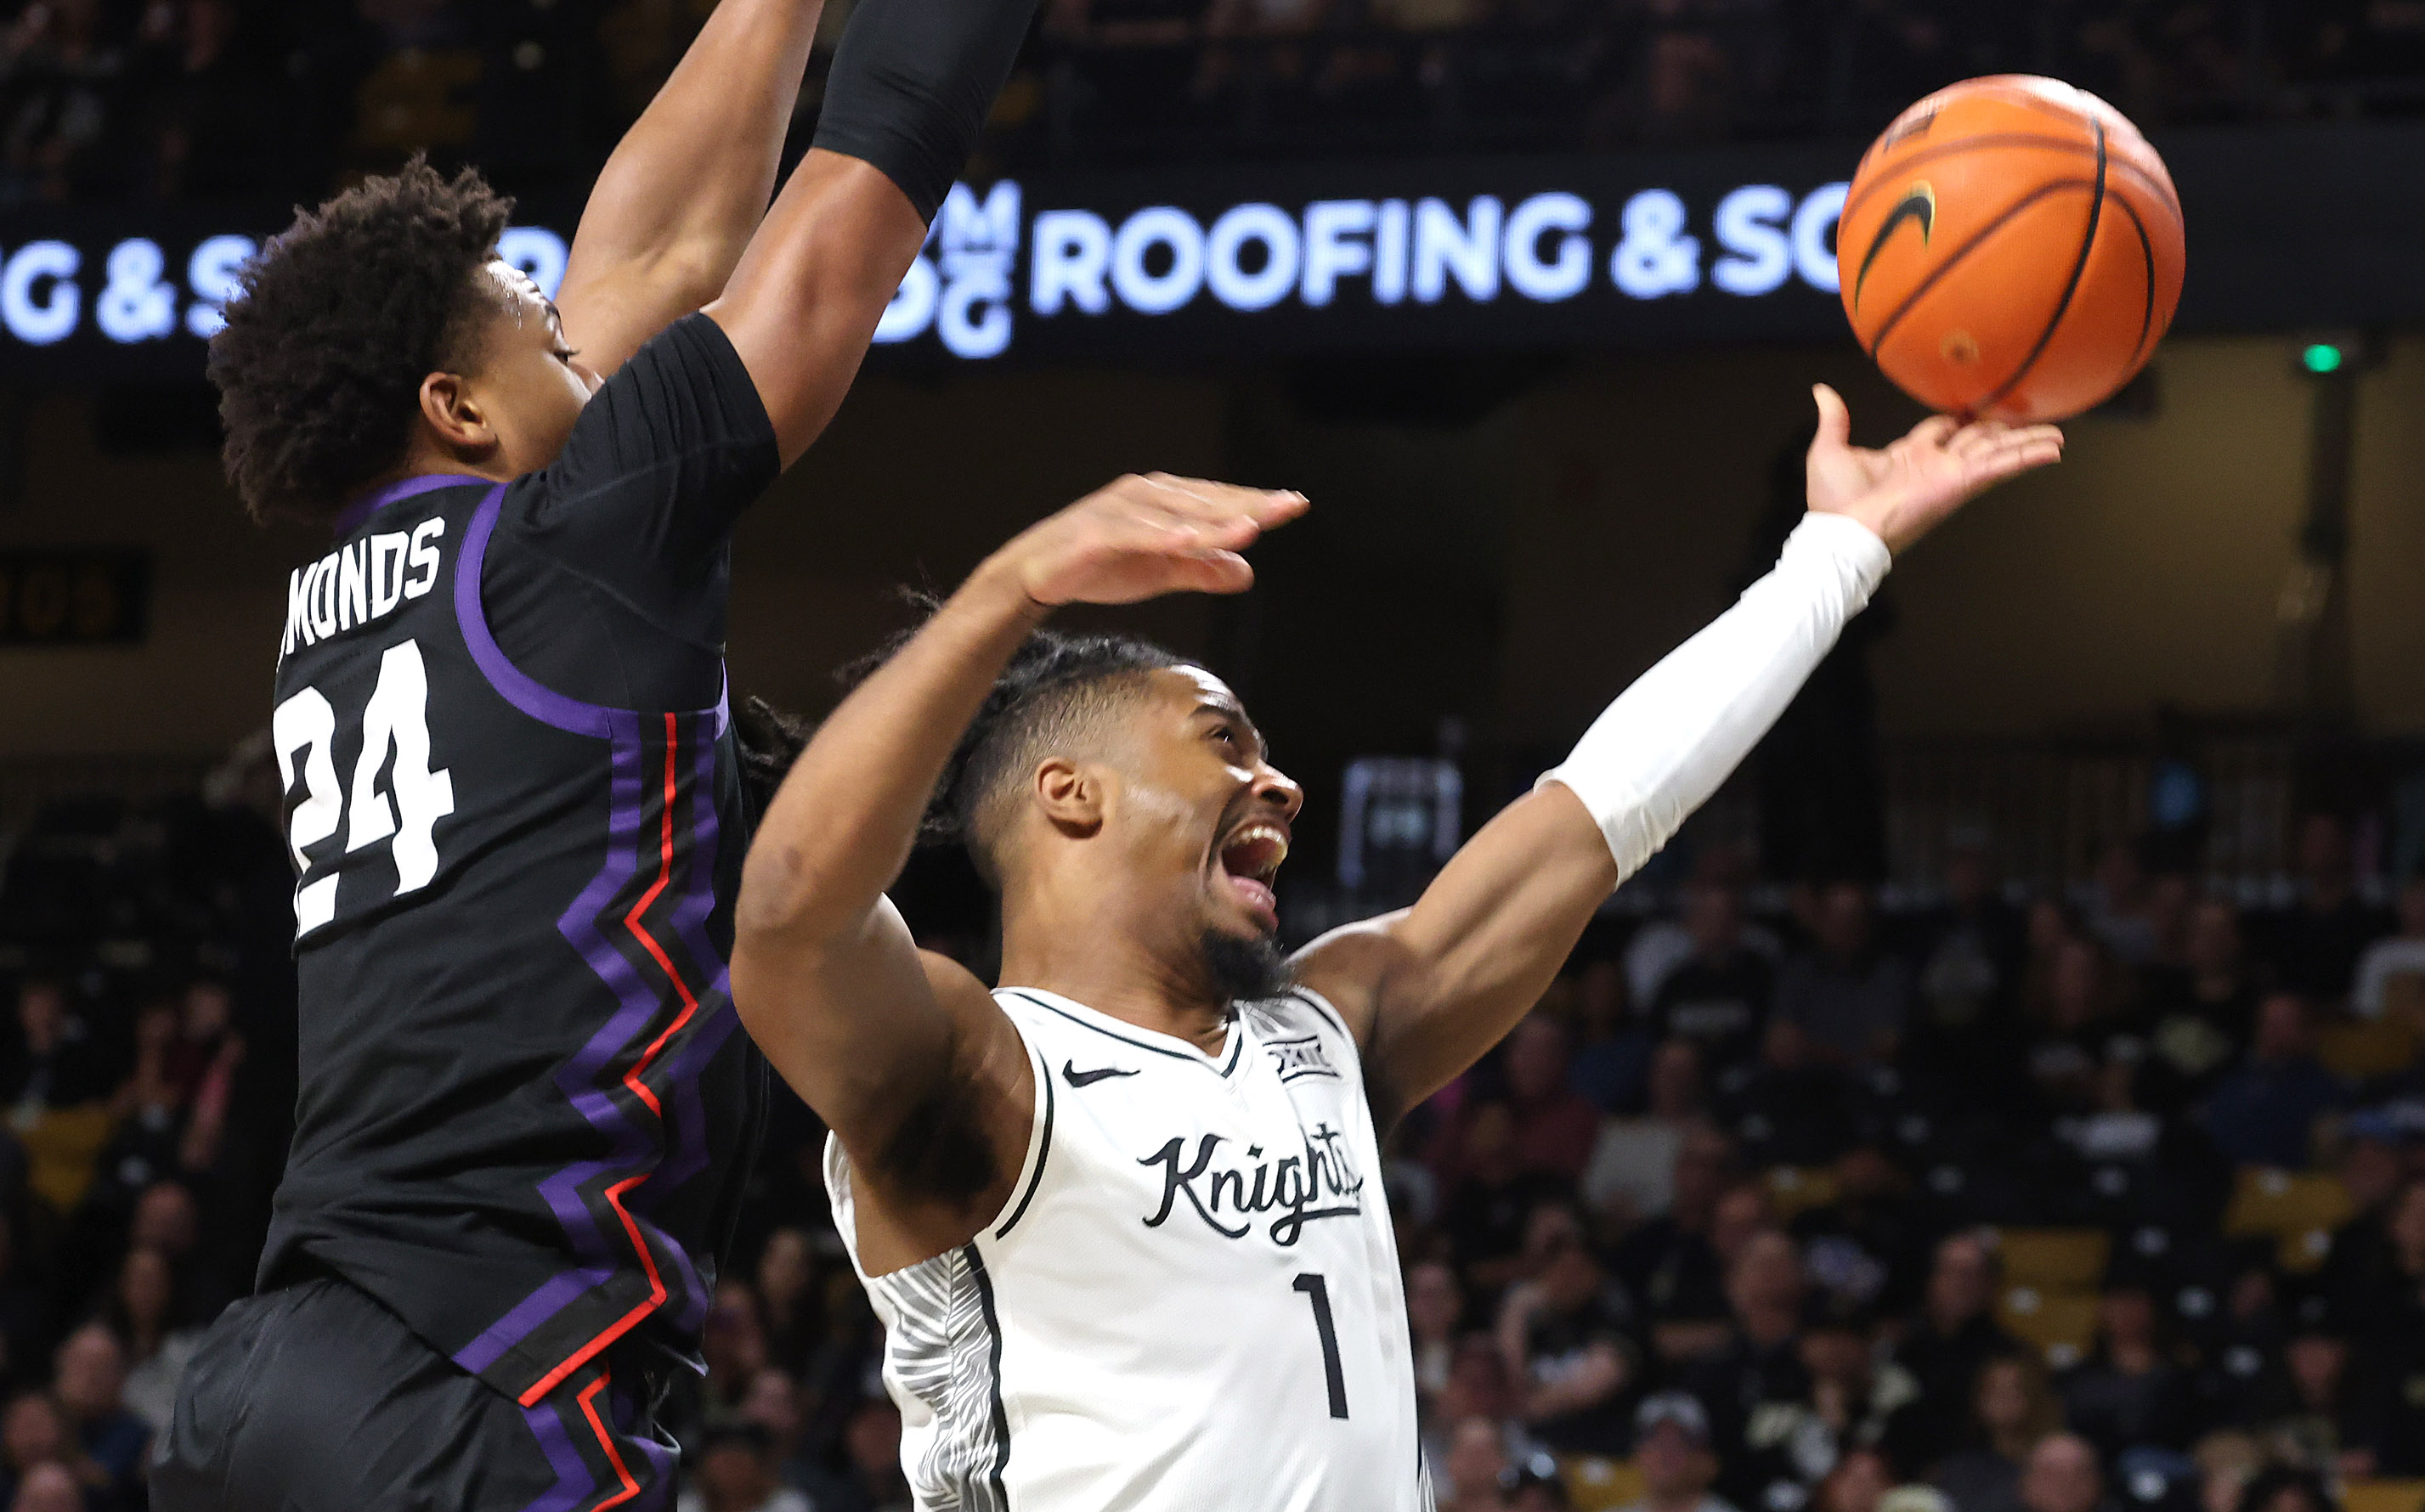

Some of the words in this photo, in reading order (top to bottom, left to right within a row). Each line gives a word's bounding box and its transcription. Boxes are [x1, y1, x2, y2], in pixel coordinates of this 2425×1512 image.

[95, 237, 178, 344] &
[1030, 190, 1593, 317] ROOFING
[1610, 187, 1702, 302] &
[1710, 179, 1851, 297] SO
[276, 516, 445, 674] MONDS
[272, 638, 455, 940] 24
[1137, 1122, 1365, 1247] Knight
[1292, 1273, 1348, 1419] 1
